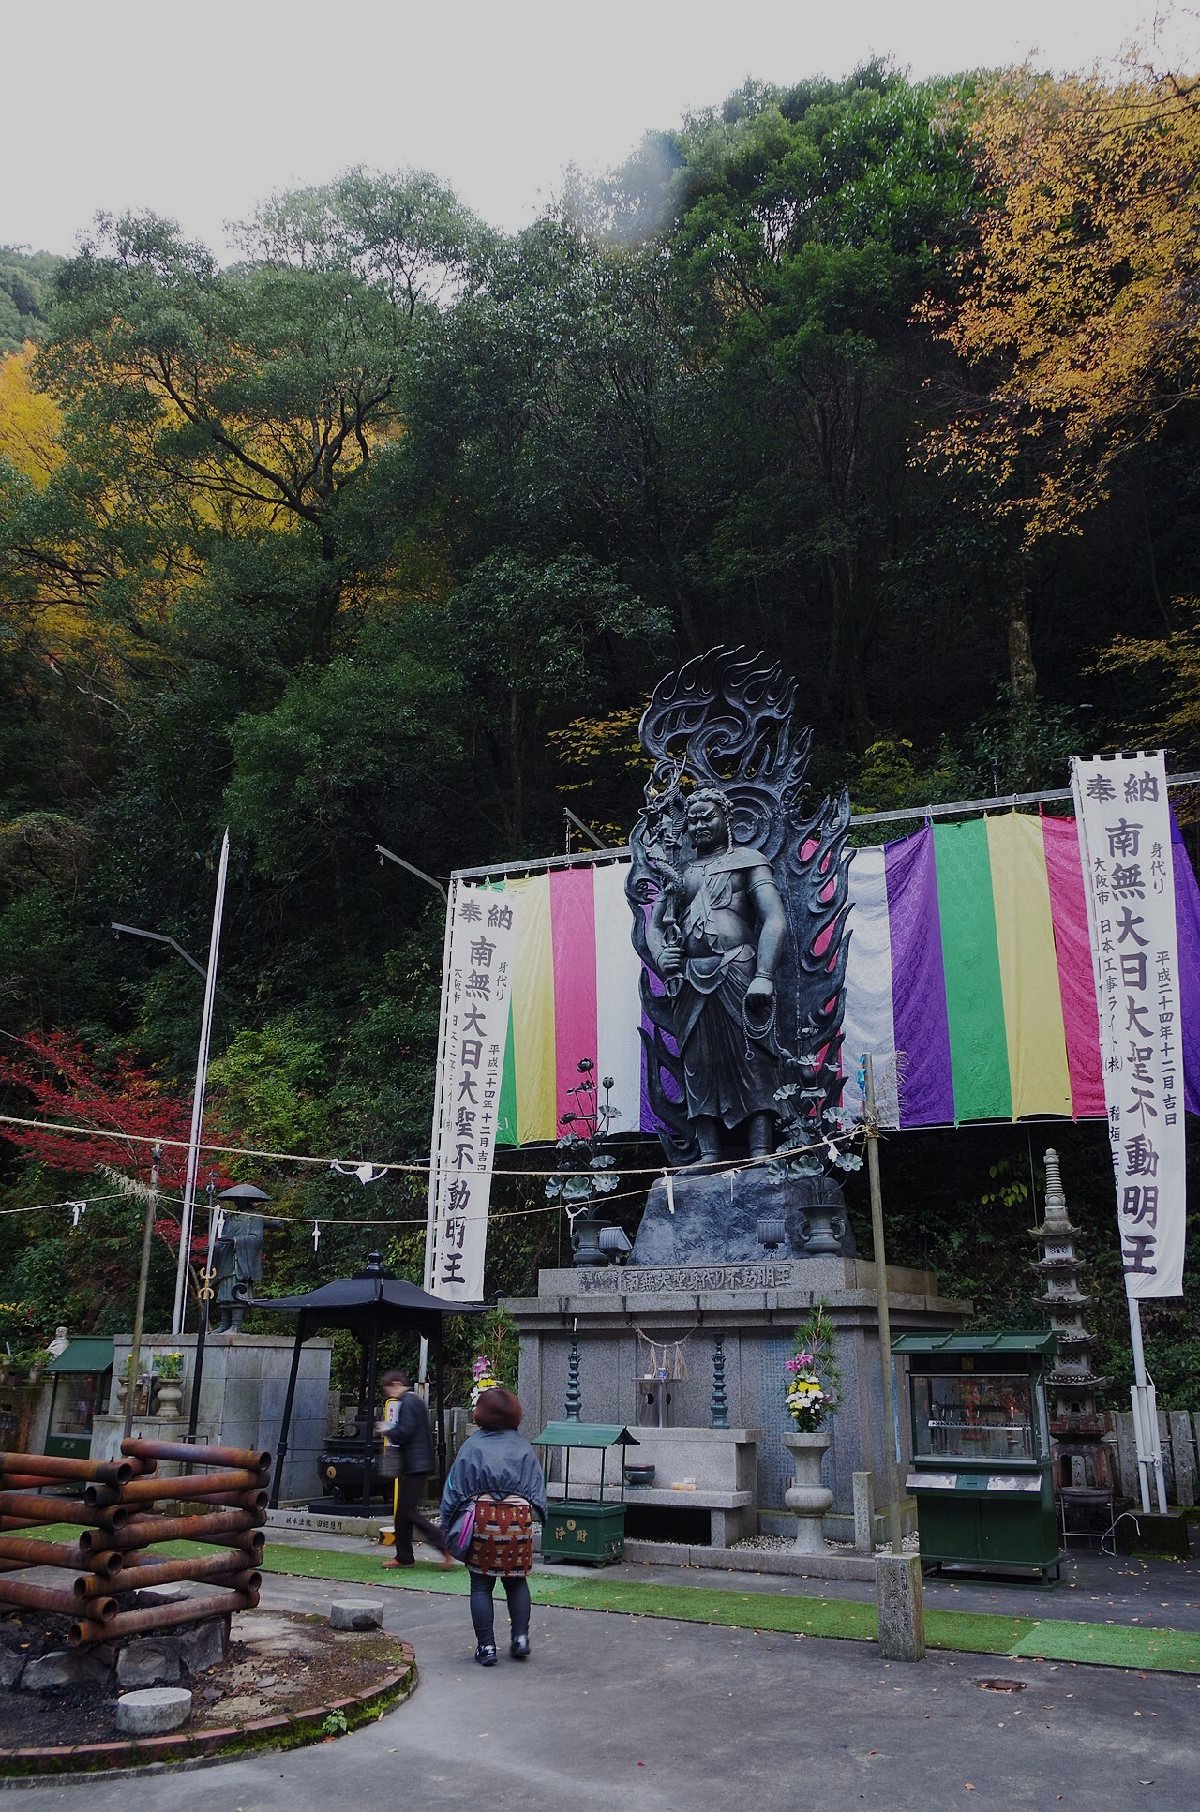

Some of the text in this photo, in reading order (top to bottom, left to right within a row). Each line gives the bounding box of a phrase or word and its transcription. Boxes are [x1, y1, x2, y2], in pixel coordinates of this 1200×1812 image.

[1086, 770, 1160, 804] 奉納
[1094, 857, 1109, 905] 大阪市
[1150, 842, 1166, 894] 身代り
[458, 899, 513, 931] 奉納
[496, 961, 508, 1001] 身代り
[1104, 817, 1160, 1276] 南無大日大聖不動明王
[1155, 950, 1178, 1127] 平成二十四年十二月吉日
[441, 936, 497, 1284] 南無大日大聖不動明王
[555, 1526, 588, 1544] 浄財
